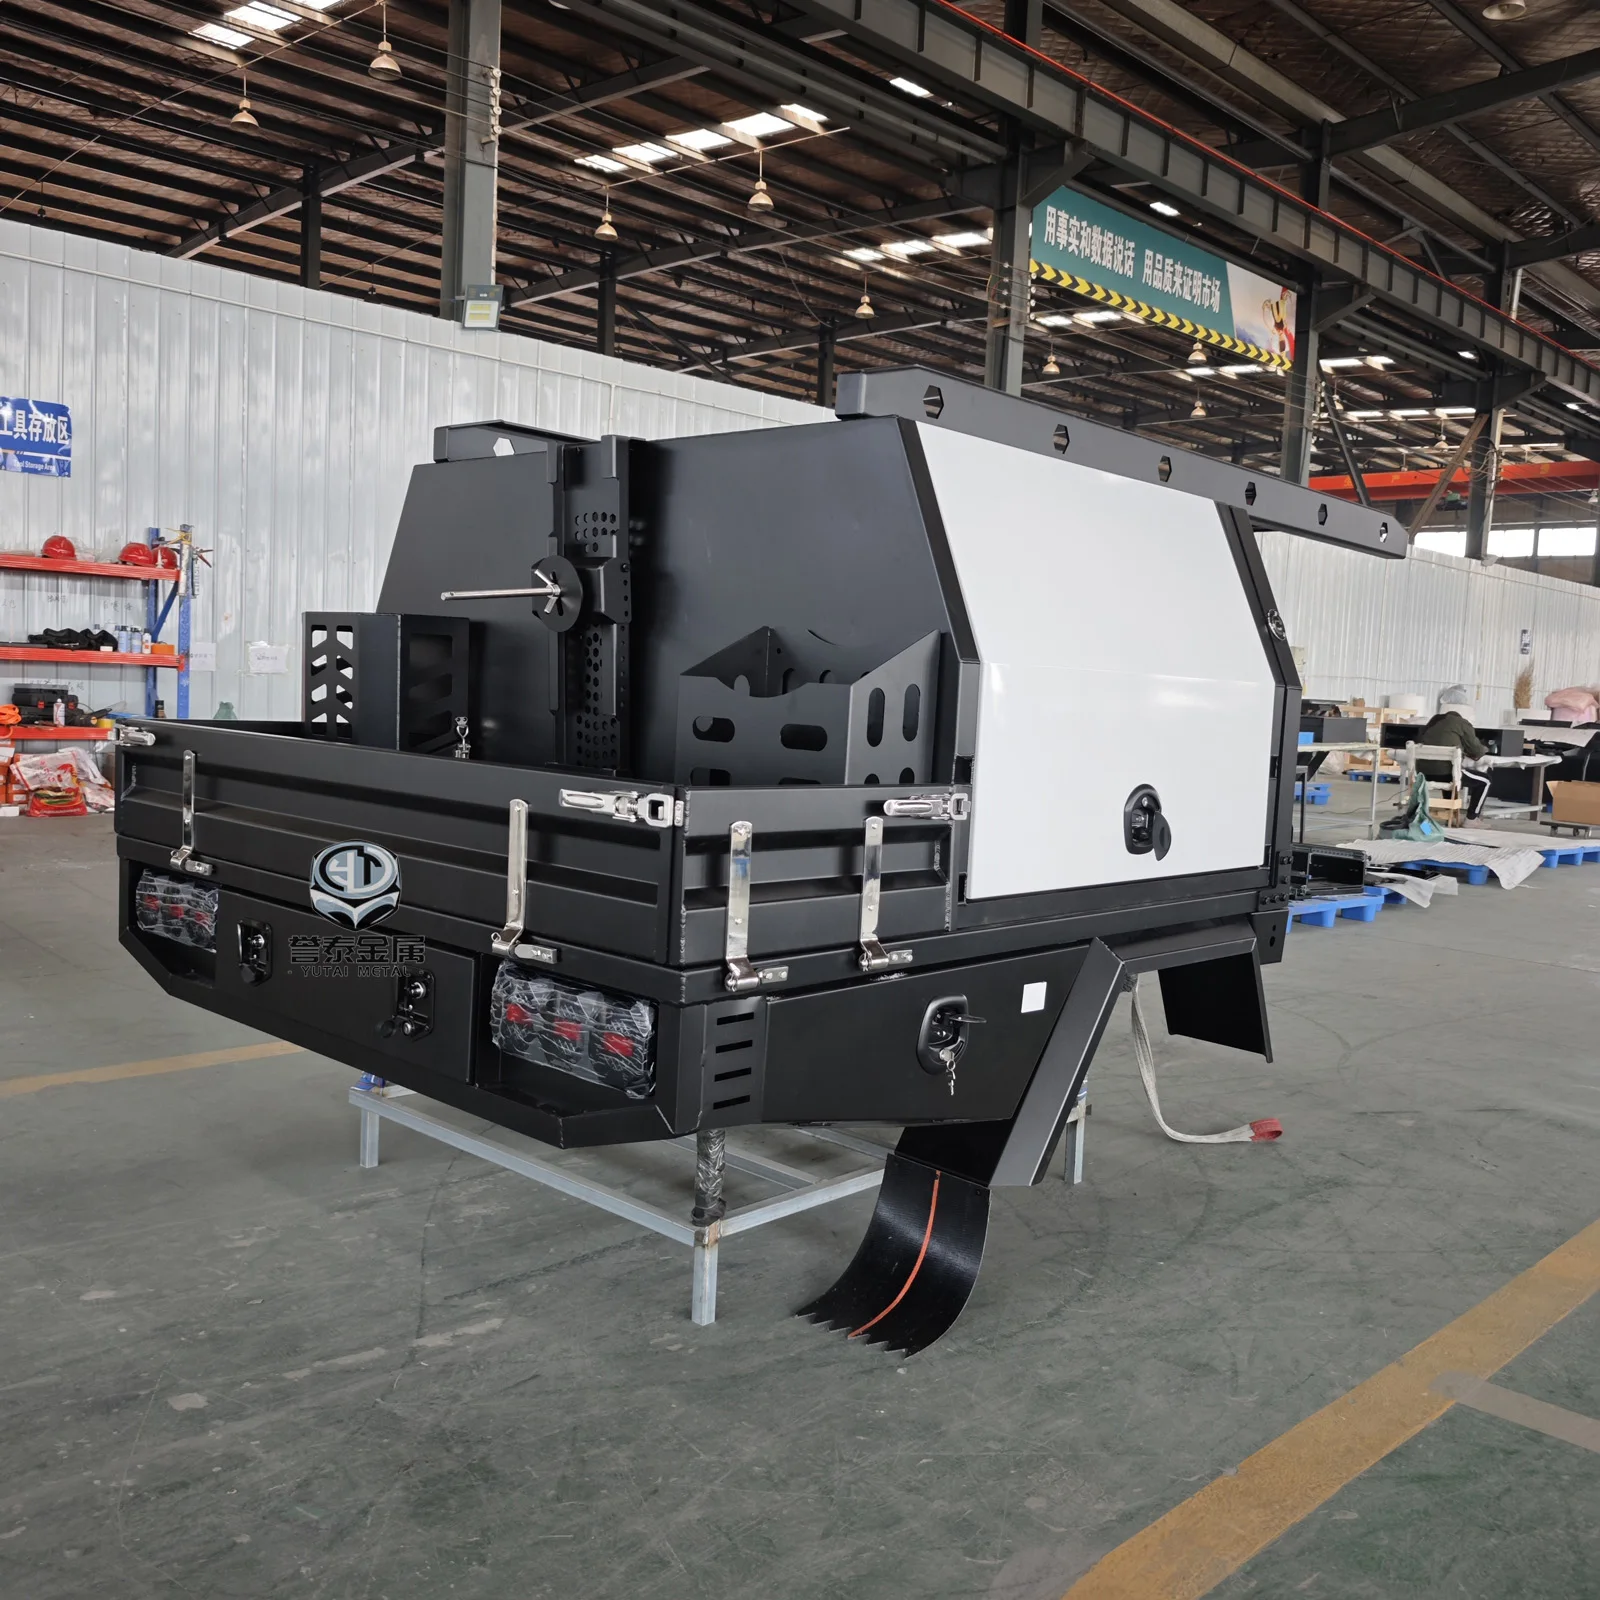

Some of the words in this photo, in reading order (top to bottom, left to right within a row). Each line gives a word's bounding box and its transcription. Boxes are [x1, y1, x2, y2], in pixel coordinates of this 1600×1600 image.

[1044, 205, 1135, 278] 用事实和数据说话
[1142, 249, 1221, 313] 用品质来证明市场
[0, 409, 69, 444] 工具存放区
